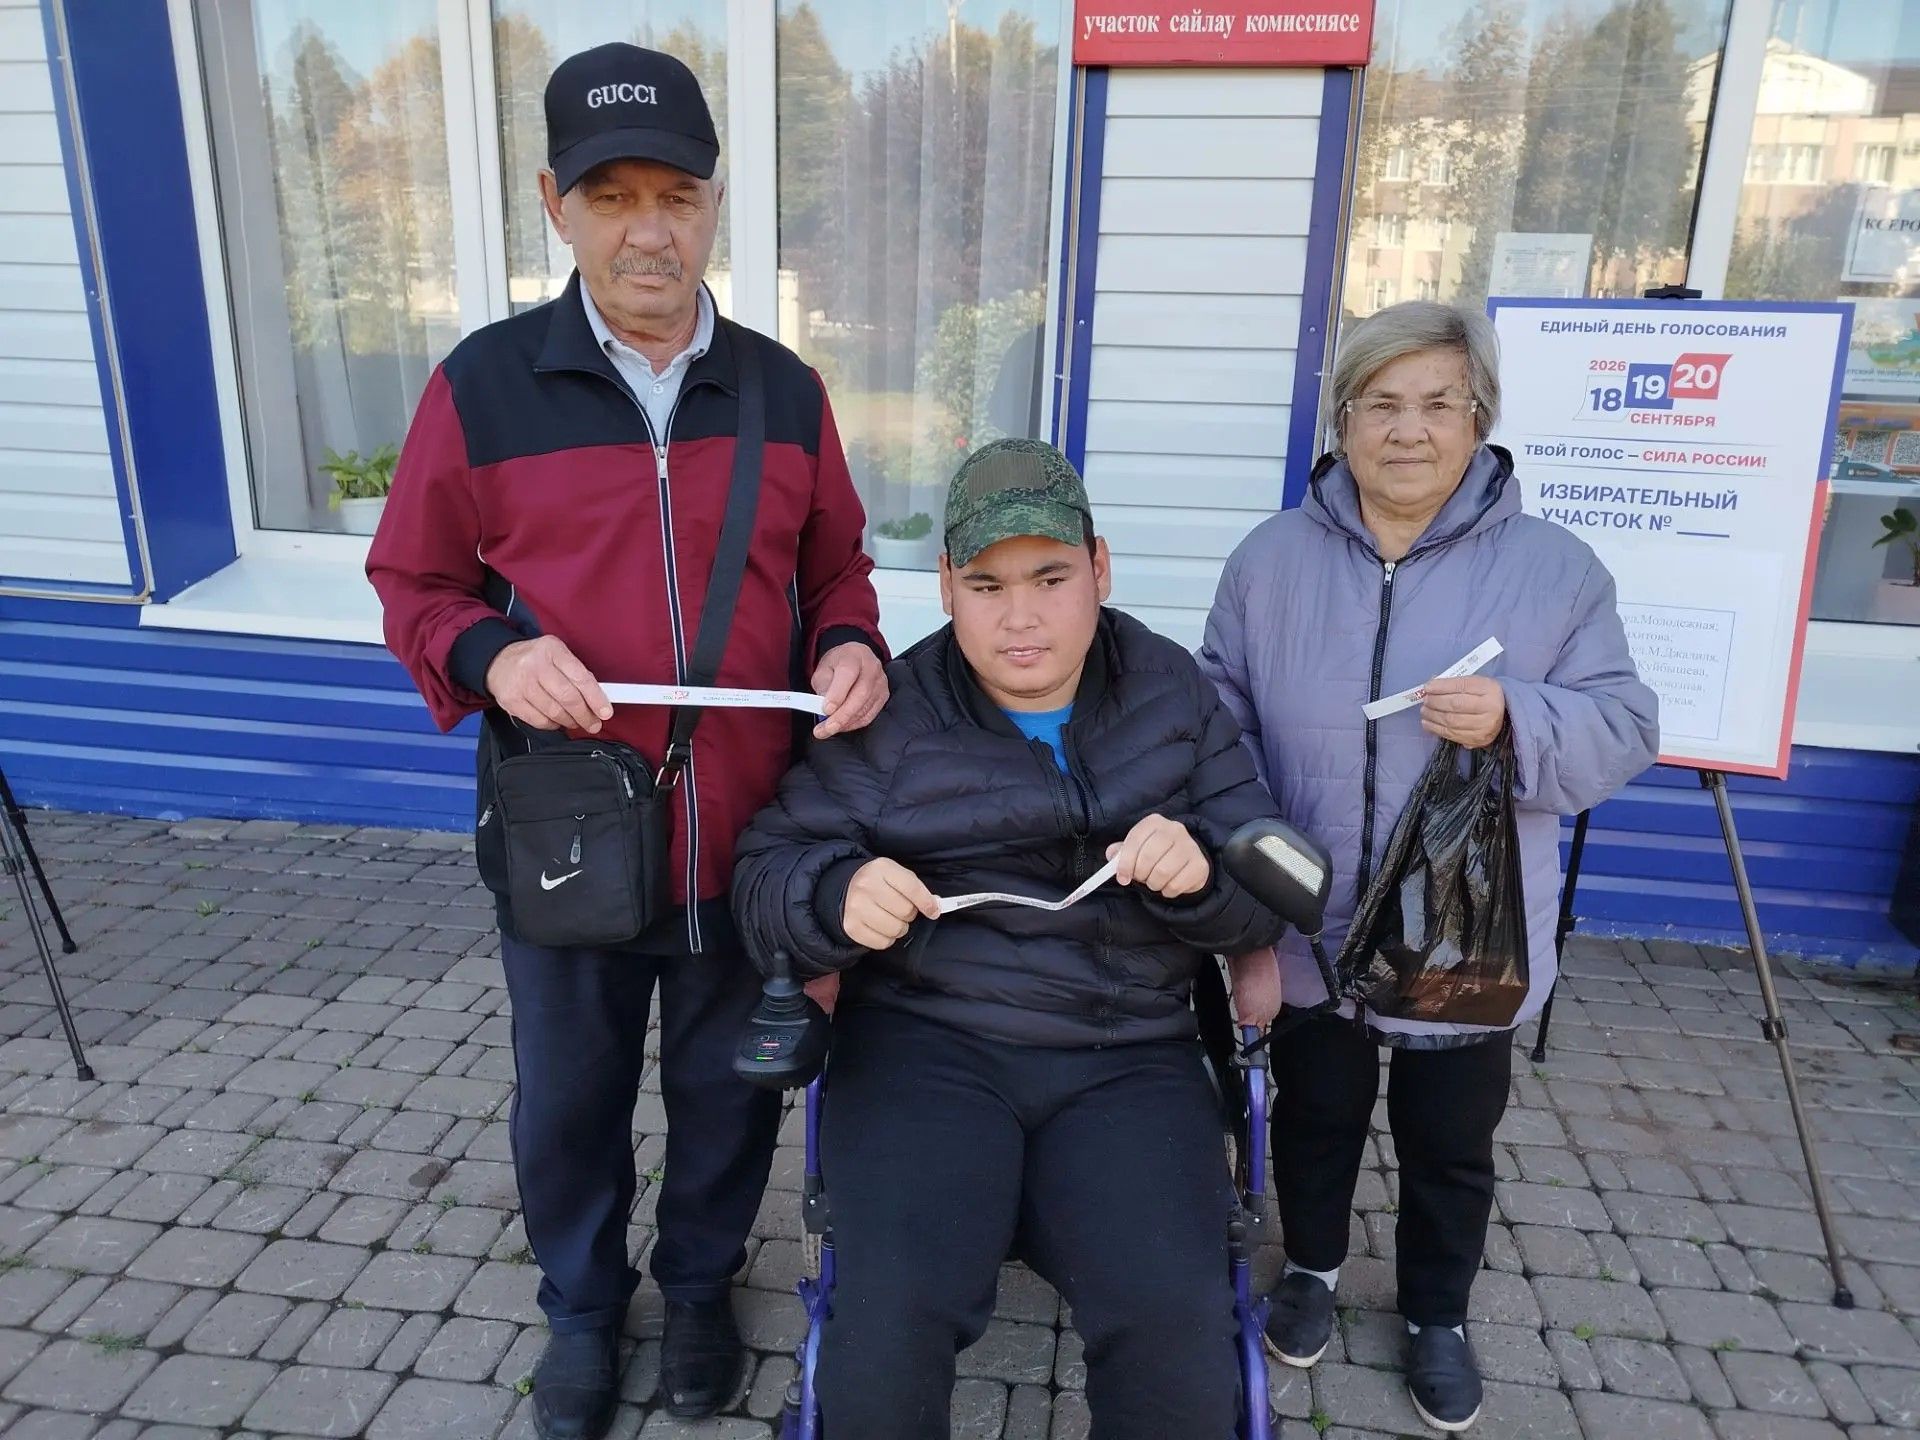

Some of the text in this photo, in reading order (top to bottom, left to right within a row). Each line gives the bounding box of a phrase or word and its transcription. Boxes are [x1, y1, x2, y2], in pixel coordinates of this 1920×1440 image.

[1083, 8, 1360, 40] участок сайлау комиссиясе
[587, 83, 658, 109] GUCCI
[1540, 320, 1787, 338] ЕДИНЫЙ ДЕНЬ ГОЛОСОВАНИЯ
[1589, 359, 1627, 372] 2026
[1590, 363, 1718, 412] 18 19 20
[1629, 412, 1716, 428] СЕНТЯБРЯ
[1524, 443, 1567, 457] ТВОЙ
[1570, 446, 1624, 460] ГОЛОС
[1642, 450, 1688, 464] СИЛА
[1691, 452, 1767, 468] РОССИИ!
[1539, 482, 1738, 511] ИЗБИРАТЕЛЬНЫЙ
[1541, 507, 1673, 531] УЧАСТОК №
